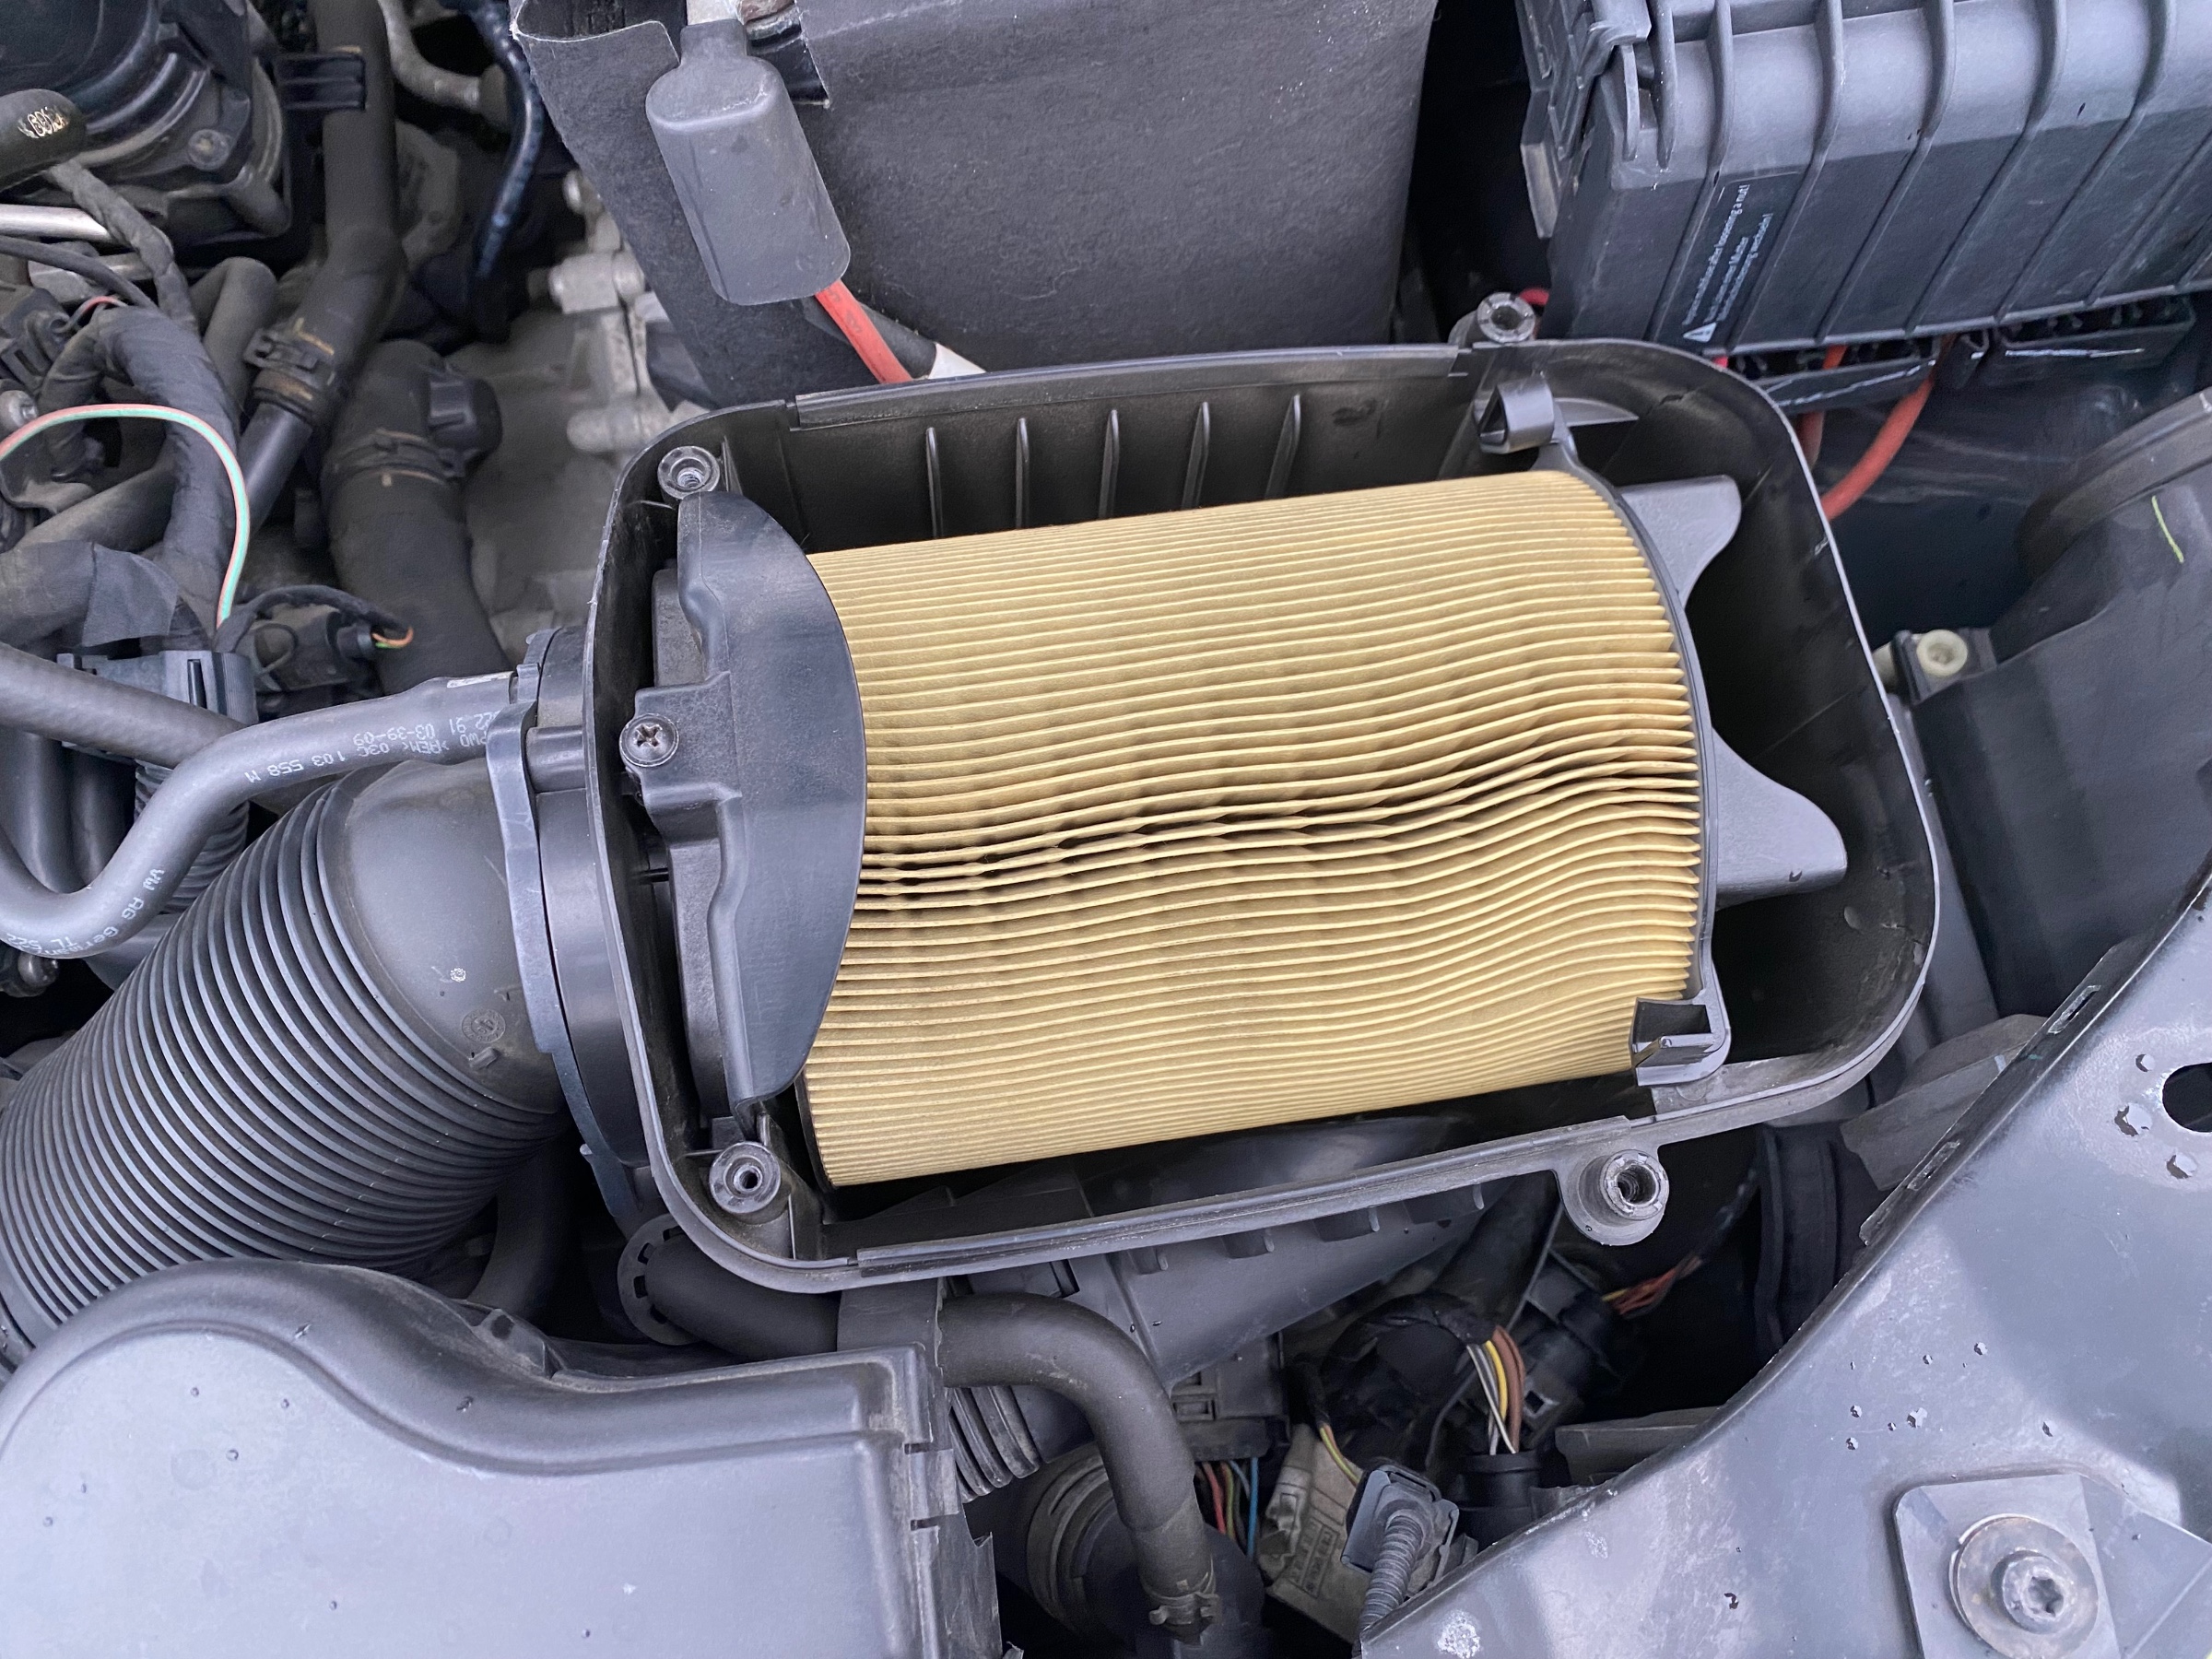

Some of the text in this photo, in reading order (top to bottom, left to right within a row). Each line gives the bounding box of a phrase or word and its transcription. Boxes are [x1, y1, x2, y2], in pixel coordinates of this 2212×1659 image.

[449, 717, 467, 735] 91
[266, 759, 304, 776] 558
[244, 770, 262, 783] M
[142, 868, 165, 891] VW
[121, 897, 145, 920] AG
[51, 936, 78, 950] TL
